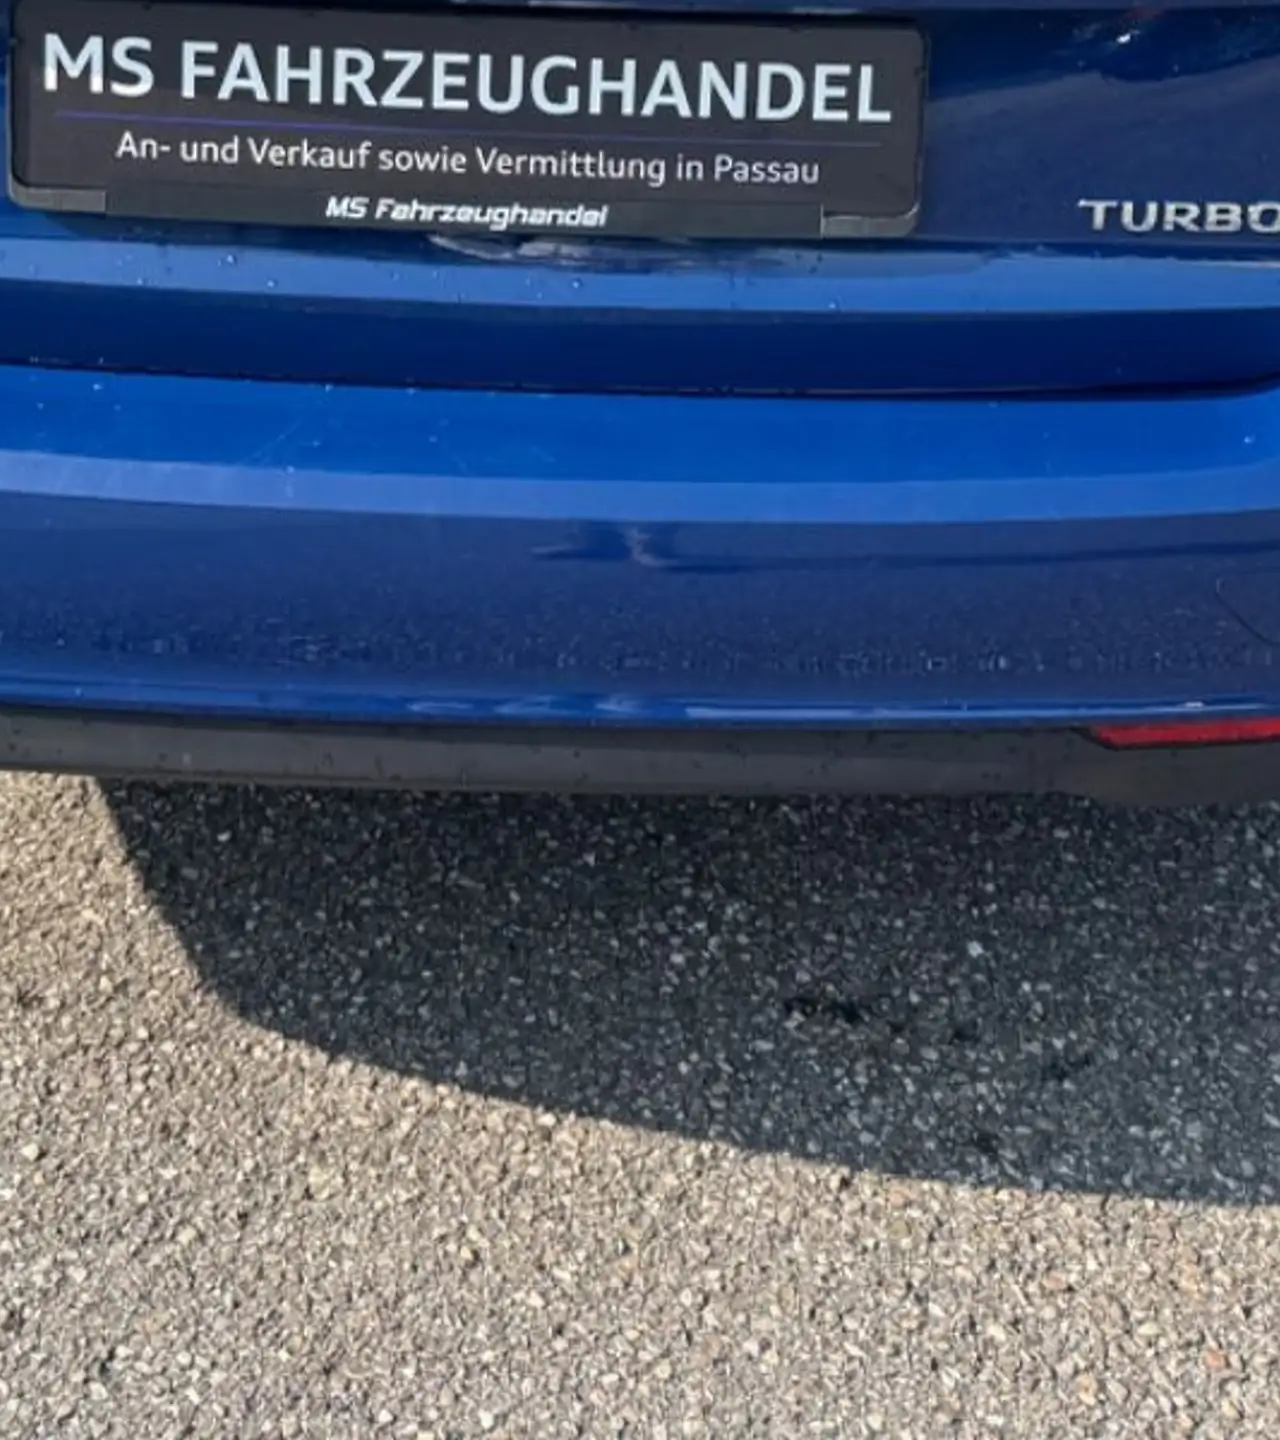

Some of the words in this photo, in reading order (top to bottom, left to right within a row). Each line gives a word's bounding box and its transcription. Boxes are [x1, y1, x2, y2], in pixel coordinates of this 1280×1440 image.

[42, 32, 155, 98] MS
[180, 39, 892, 124] FAHRZEUGHANDEL
[115, 130, 172, 160] An-
[179, 134, 240, 164] und
[247, 136, 372, 170] Verkauf
[378, 144, 467, 174] sowie
[475, 146, 666, 186] Vermittlung
[676, 152, 704, 180] in
[714, 155, 820, 185] Passau
[325, 195, 370, 220] MS
[374, 197, 610, 232] Fahrzeughandel
